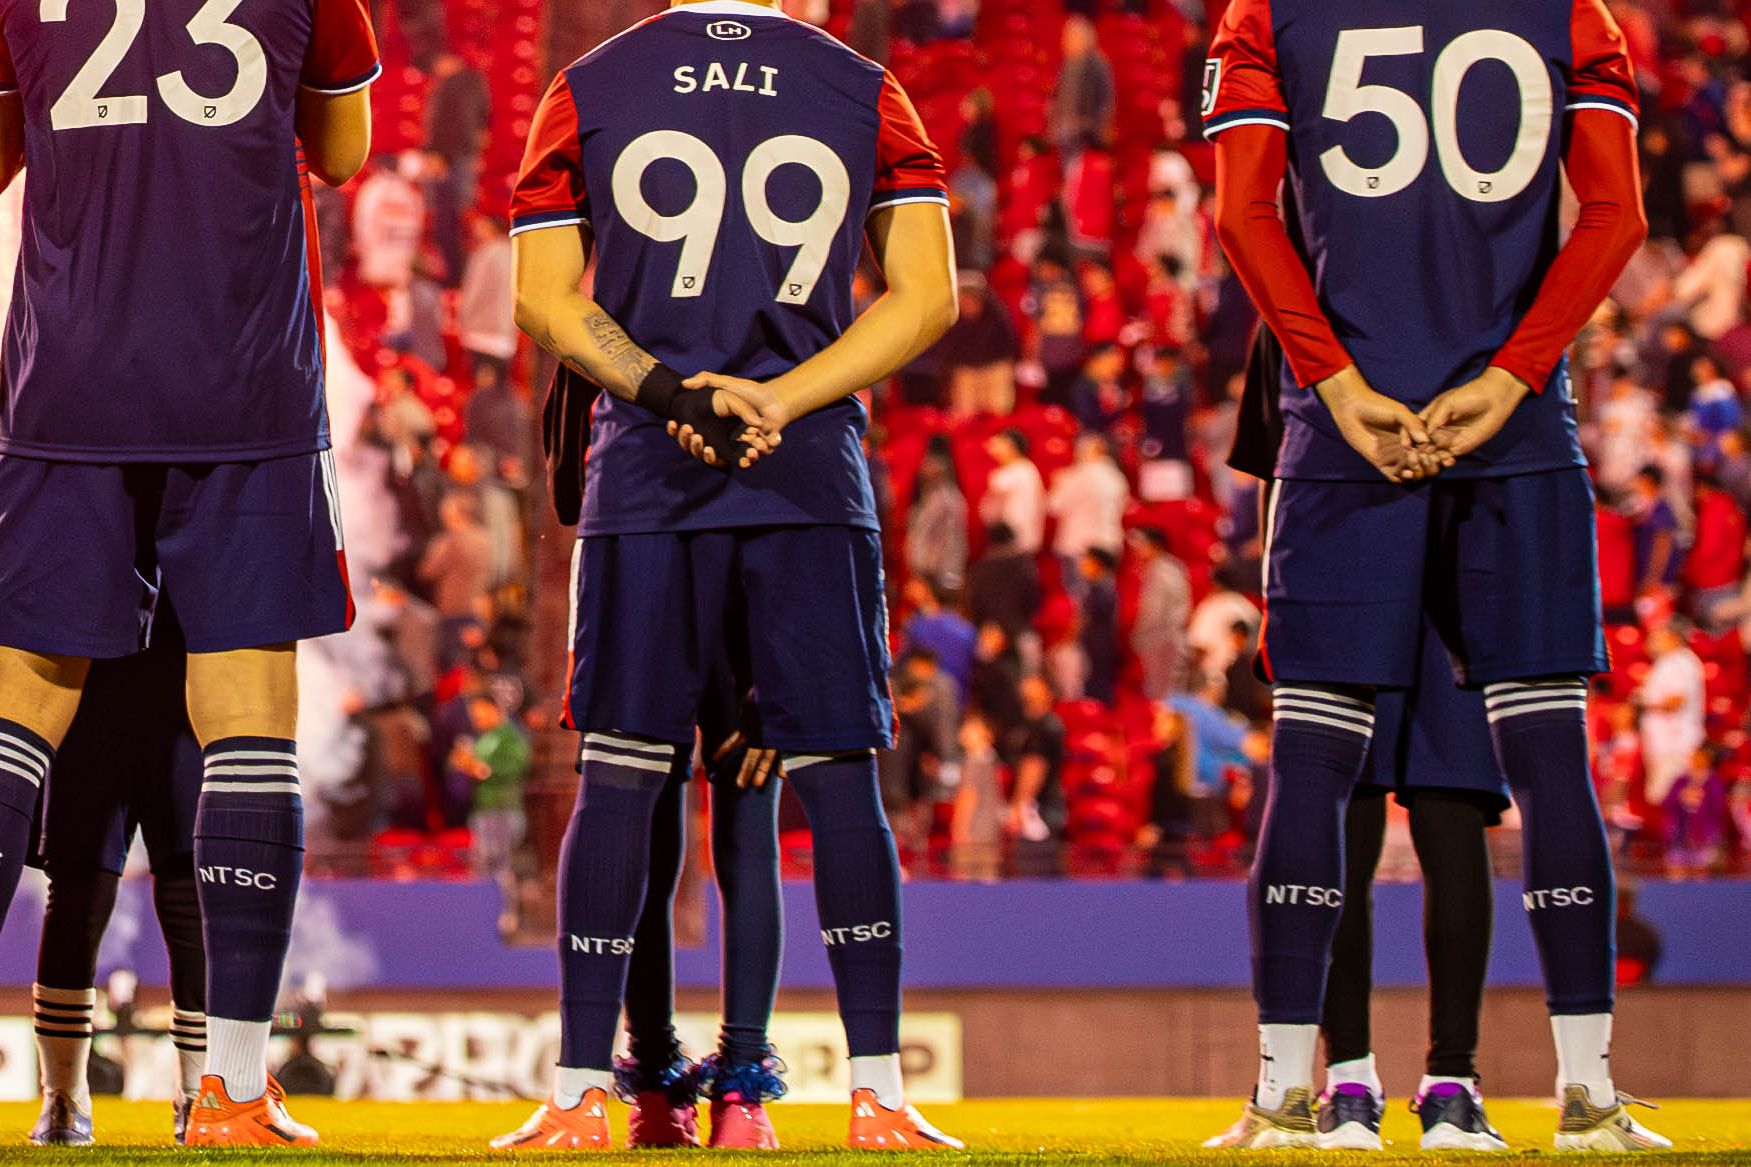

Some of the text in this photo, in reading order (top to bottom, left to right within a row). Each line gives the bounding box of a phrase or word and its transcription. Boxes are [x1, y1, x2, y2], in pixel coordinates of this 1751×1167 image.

[673, 62, 779, 97] SALI
[1319, 25, 1553, 203] 50
[611, 129, 851, 306] 99
[199, 865, 277, 890] NTSC
[1266, 884, 1342, 908] NTSC
[1522, 886, 1594, 912] NTSC
[820, 921, 891, 946] NTSC
